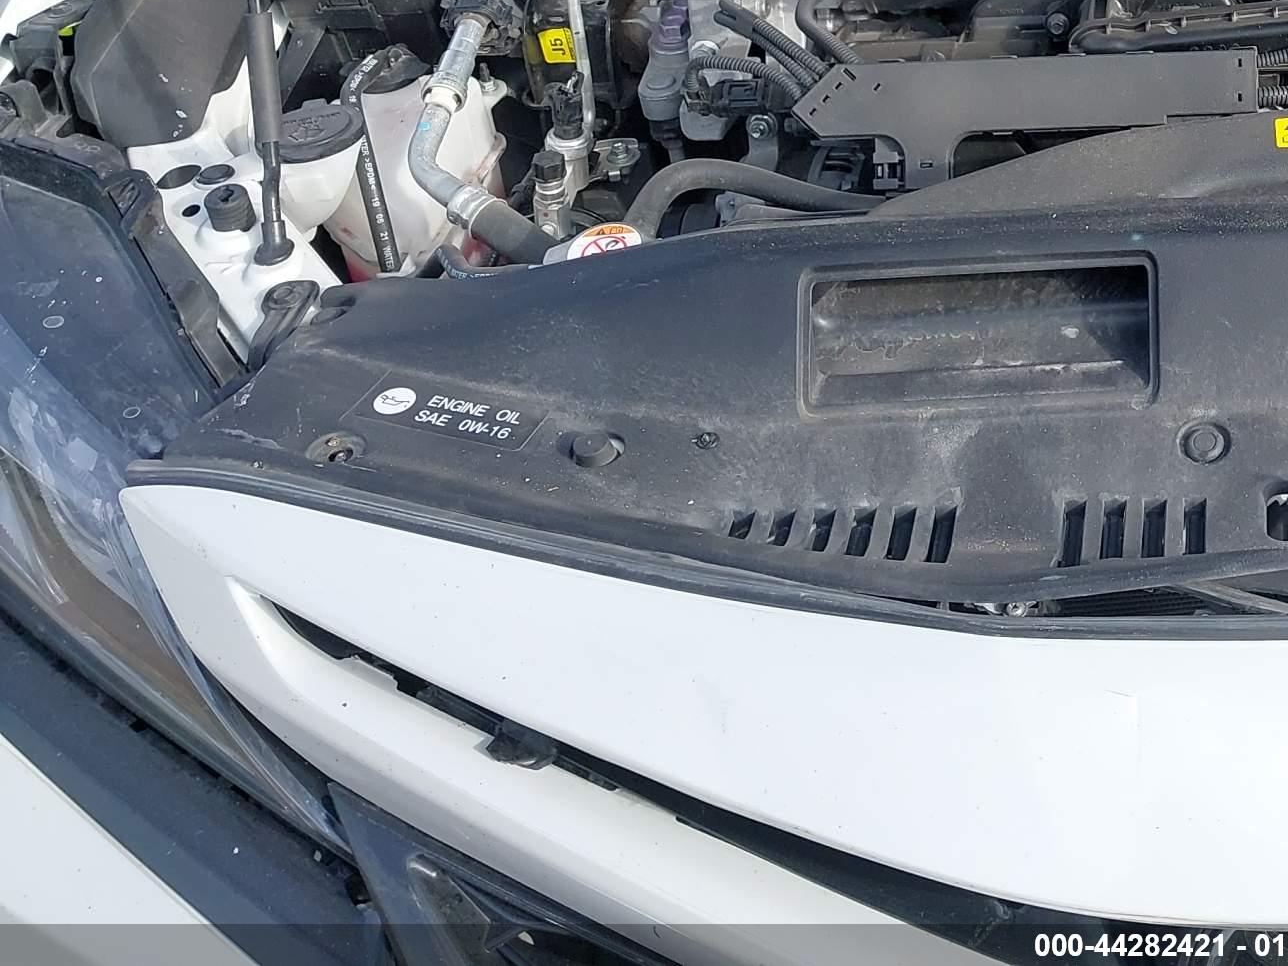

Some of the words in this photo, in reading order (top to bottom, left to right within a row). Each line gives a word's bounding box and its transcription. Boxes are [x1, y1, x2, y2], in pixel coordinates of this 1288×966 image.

[549, 37, 566, 56] J5
[380, 231, 389, 241] 21
[427, 395, 490, 417] ENGINE
[495, 409, 521, 425] OIL
[414, 409, 453, 427] SAE
[458, 419, 512, 439] 0W-16
